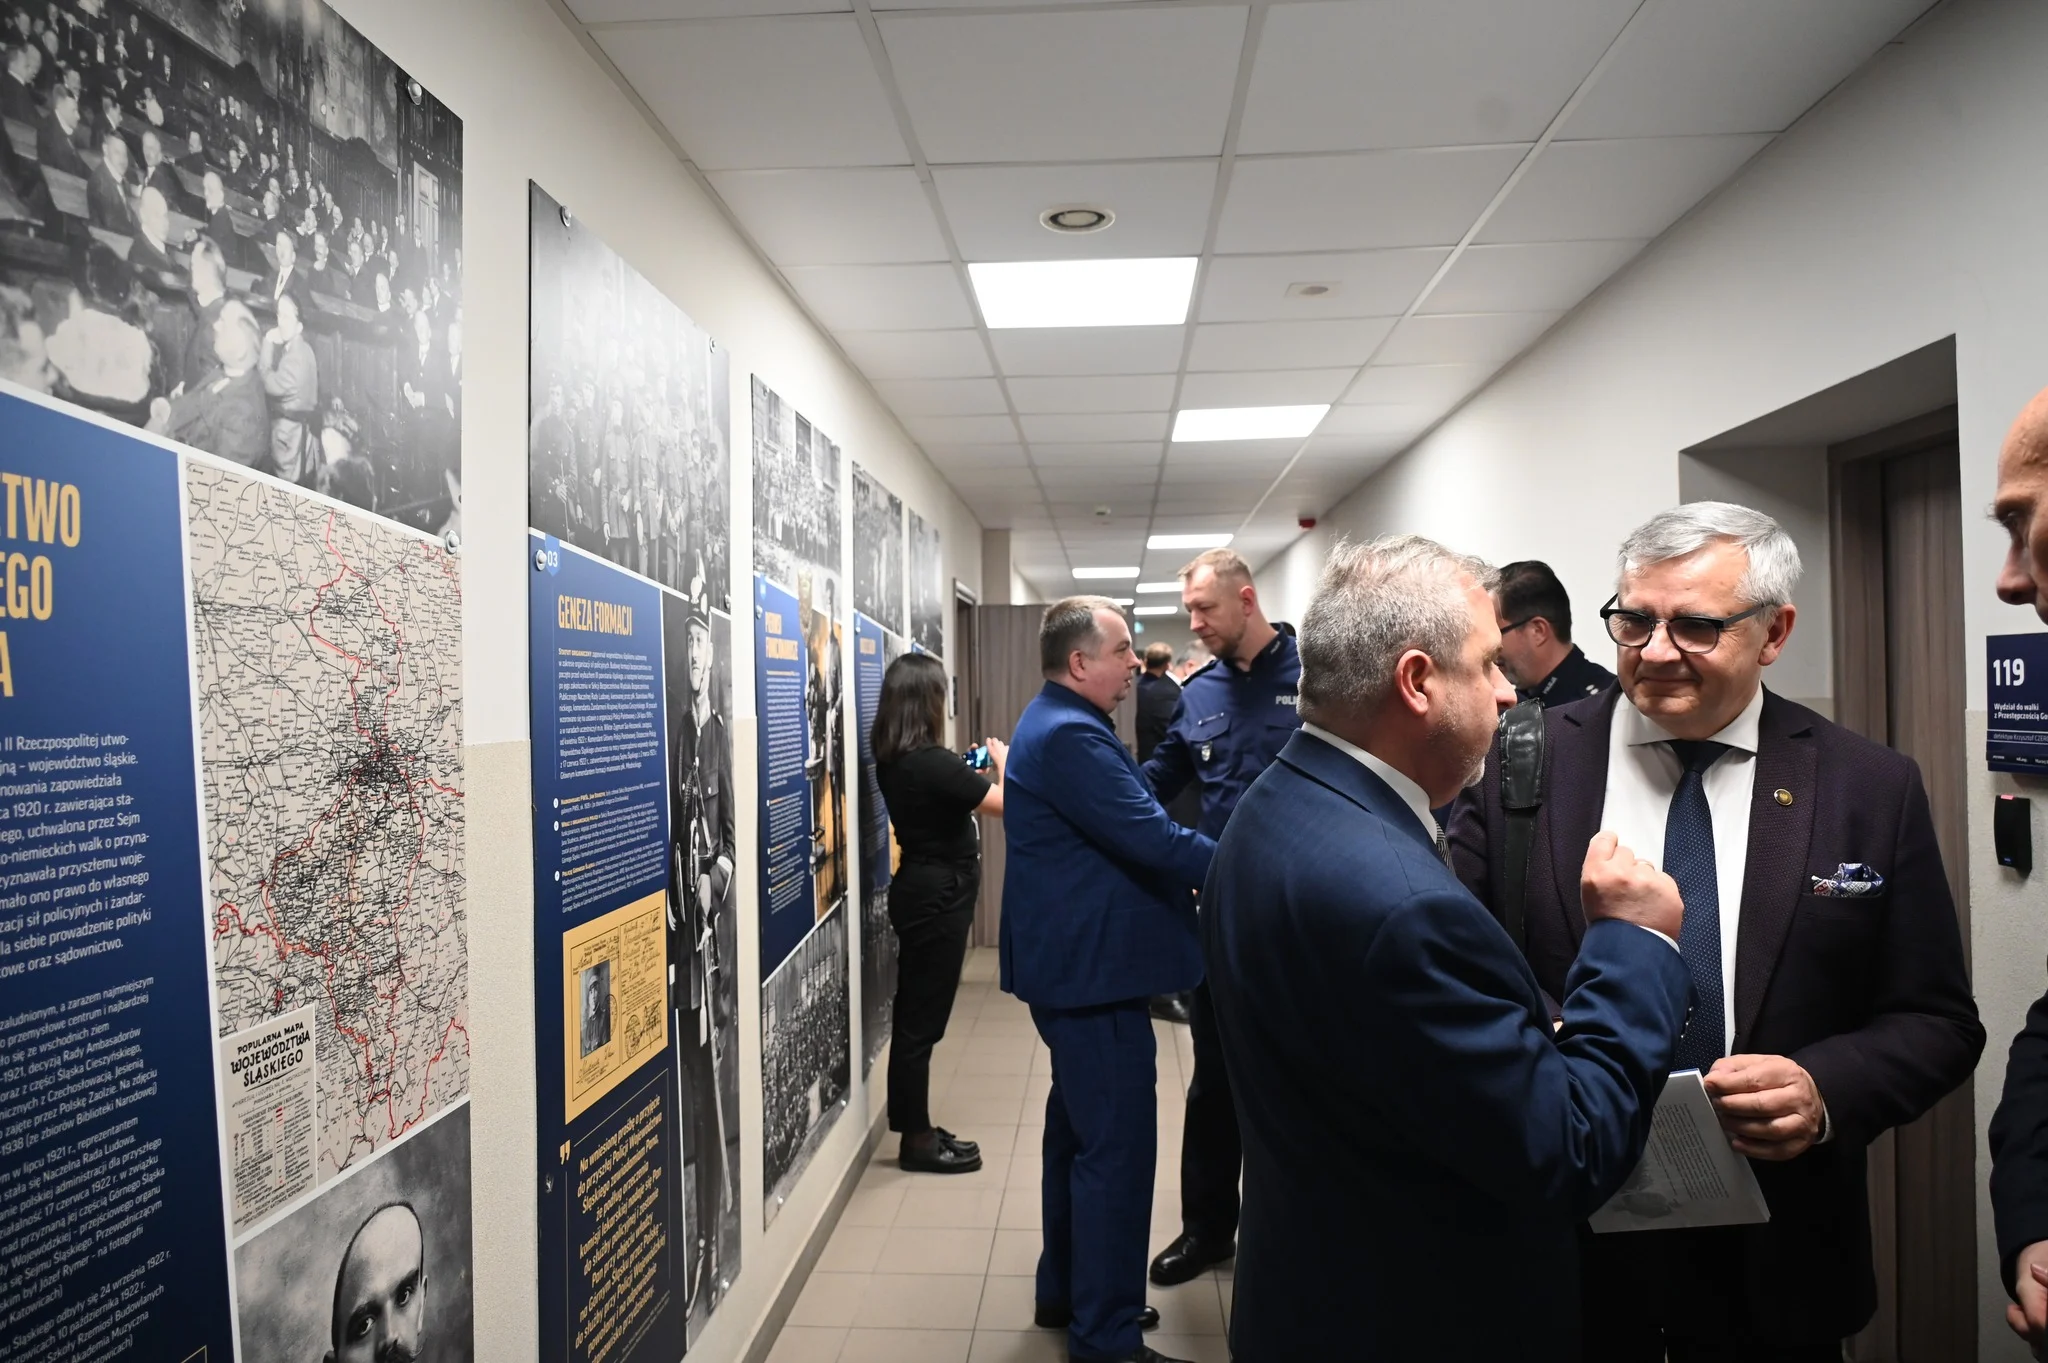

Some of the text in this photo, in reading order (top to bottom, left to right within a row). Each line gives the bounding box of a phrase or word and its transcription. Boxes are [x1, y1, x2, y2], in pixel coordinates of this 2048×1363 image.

[0, 472, 81, 548] TWO
[558, 594, 632, 636] GENEZA FORMACJI
[1993, 658, 2025, 686] 119
[1275, 695, 1298, 705] POLI
[1994, 703, 2015, 711] Wydział
[2024, 703, 2039, 711] walki
[1998, 712, 2039, 721] Przestępczością
[4, 732, 129, 751] II Rzeczpospolitej utwo-
[28, 751, 138, 773] województwo śląskie.
[0, 772, 121, 797] nowania zapowiedziała
[13, 794, 134, 817] 1920 zawierająca sta-
[27, 811, 140, 838] uchwalona przez Sejm
[0, 833, 149, 864] o-niemieckich walk przyna-
[58, 851, 145, 879] przyszłemu woje-
[0, 871, 149, 909] mało ono prawo do własnego
[0, 891, 145, 933] zacji sił policyjnych żandar-
[14, 907, 151, 951] siebie prowadzenie polityki
[0, 938, 123, 978] owe oraz sądownictwo.
[230, 1028, 311, 1074] WOJEWÓDZTWA
[237, 1022, 304, 1055] POPULARNA MAPA
[242, 1049, 303, 1088] ŚLĄSKIEGO
[0, 1097, 38, 1120] nicznych
[0, 1293, 20, 1312] skim
